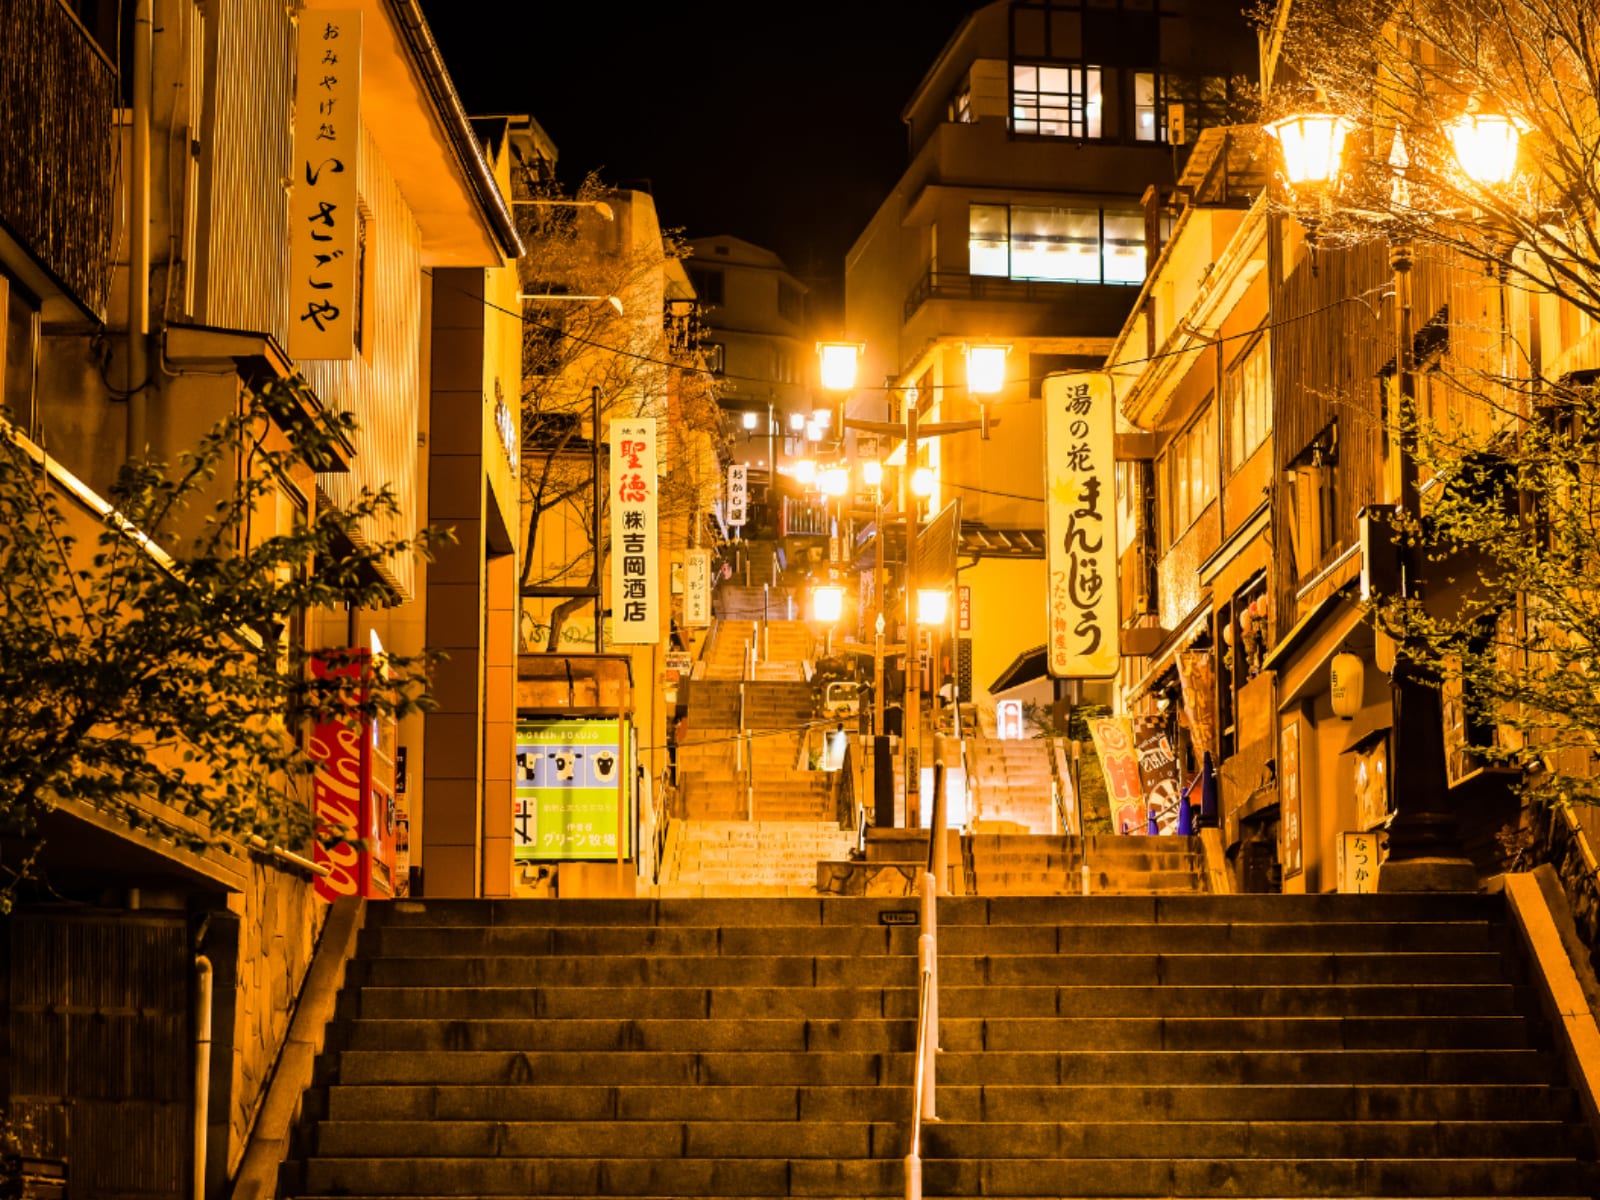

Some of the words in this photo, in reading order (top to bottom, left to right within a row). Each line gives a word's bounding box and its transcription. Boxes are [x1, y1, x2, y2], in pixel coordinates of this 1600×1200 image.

[315, 22, 339, 141] おみやげ処
[301, 157, 344, 332] いさごや
[619, 440, 650, 503] 聖徳
[1052, 569, 1067, 667] つたや物産店
[542, 831, 617, 847] グリーン牧場
